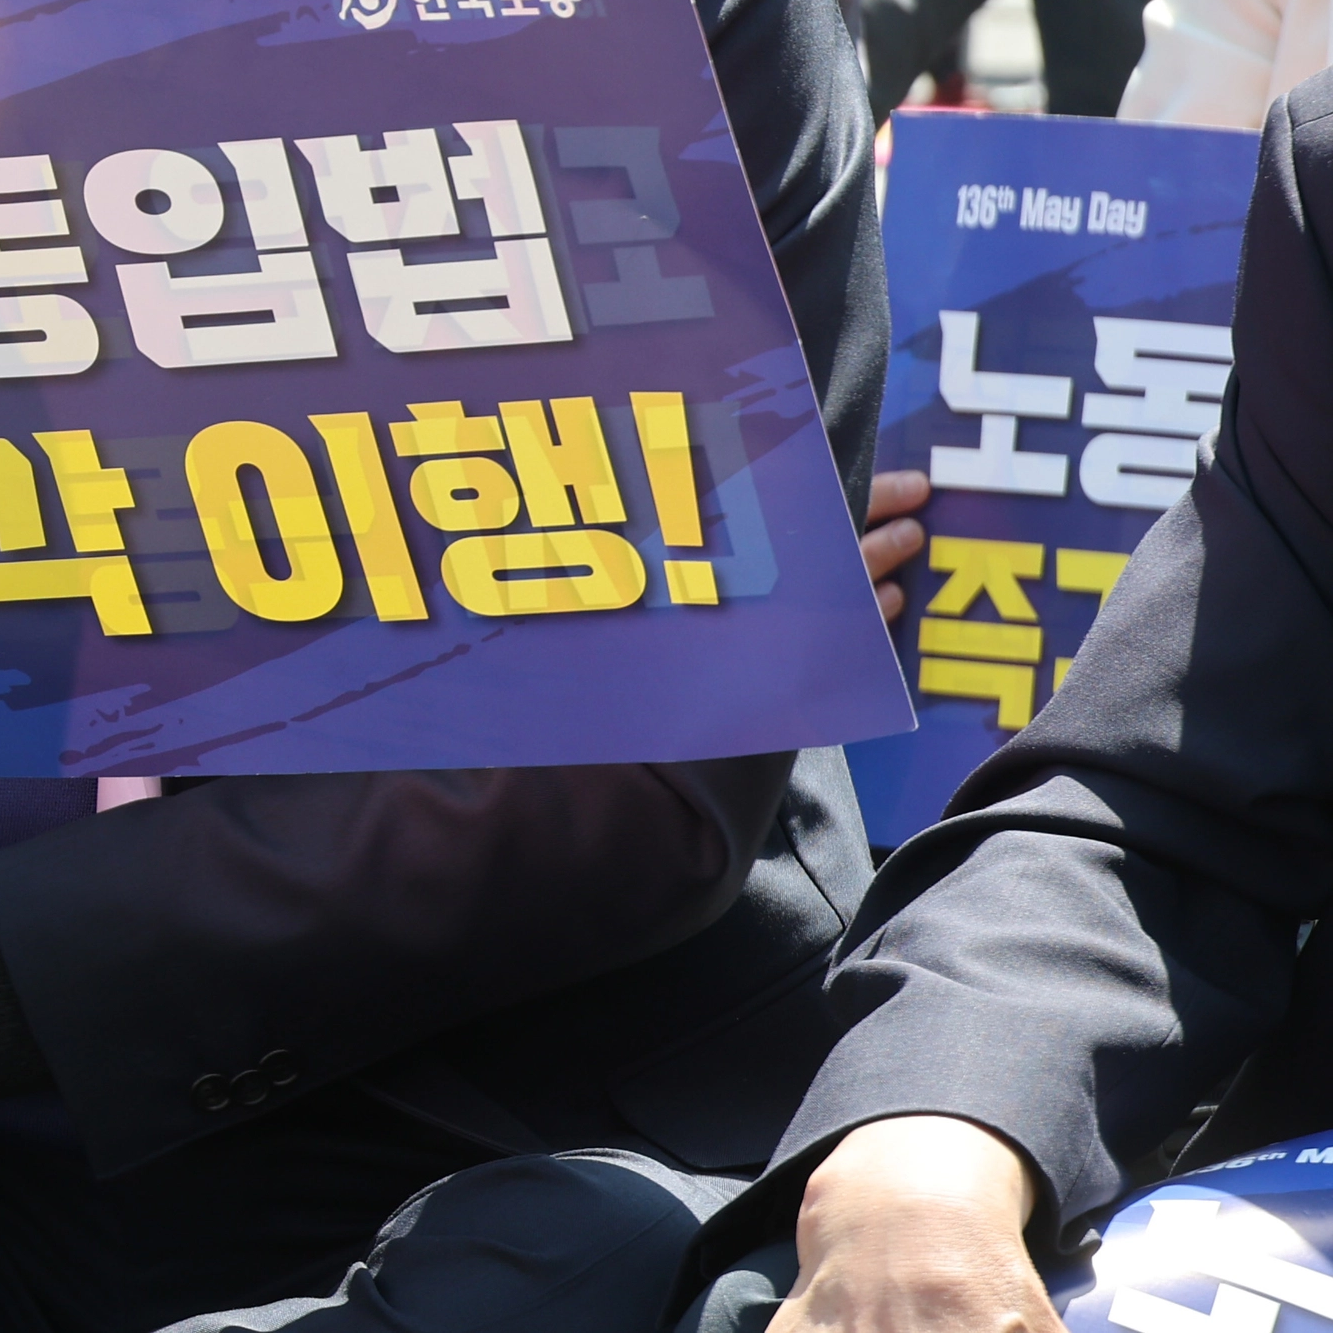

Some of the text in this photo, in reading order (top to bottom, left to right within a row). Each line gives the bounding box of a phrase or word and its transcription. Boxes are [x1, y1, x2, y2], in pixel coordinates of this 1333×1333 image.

[956, 184, 1148, 239] 136th May Day
[185, 391, 719, 623] 이행!
